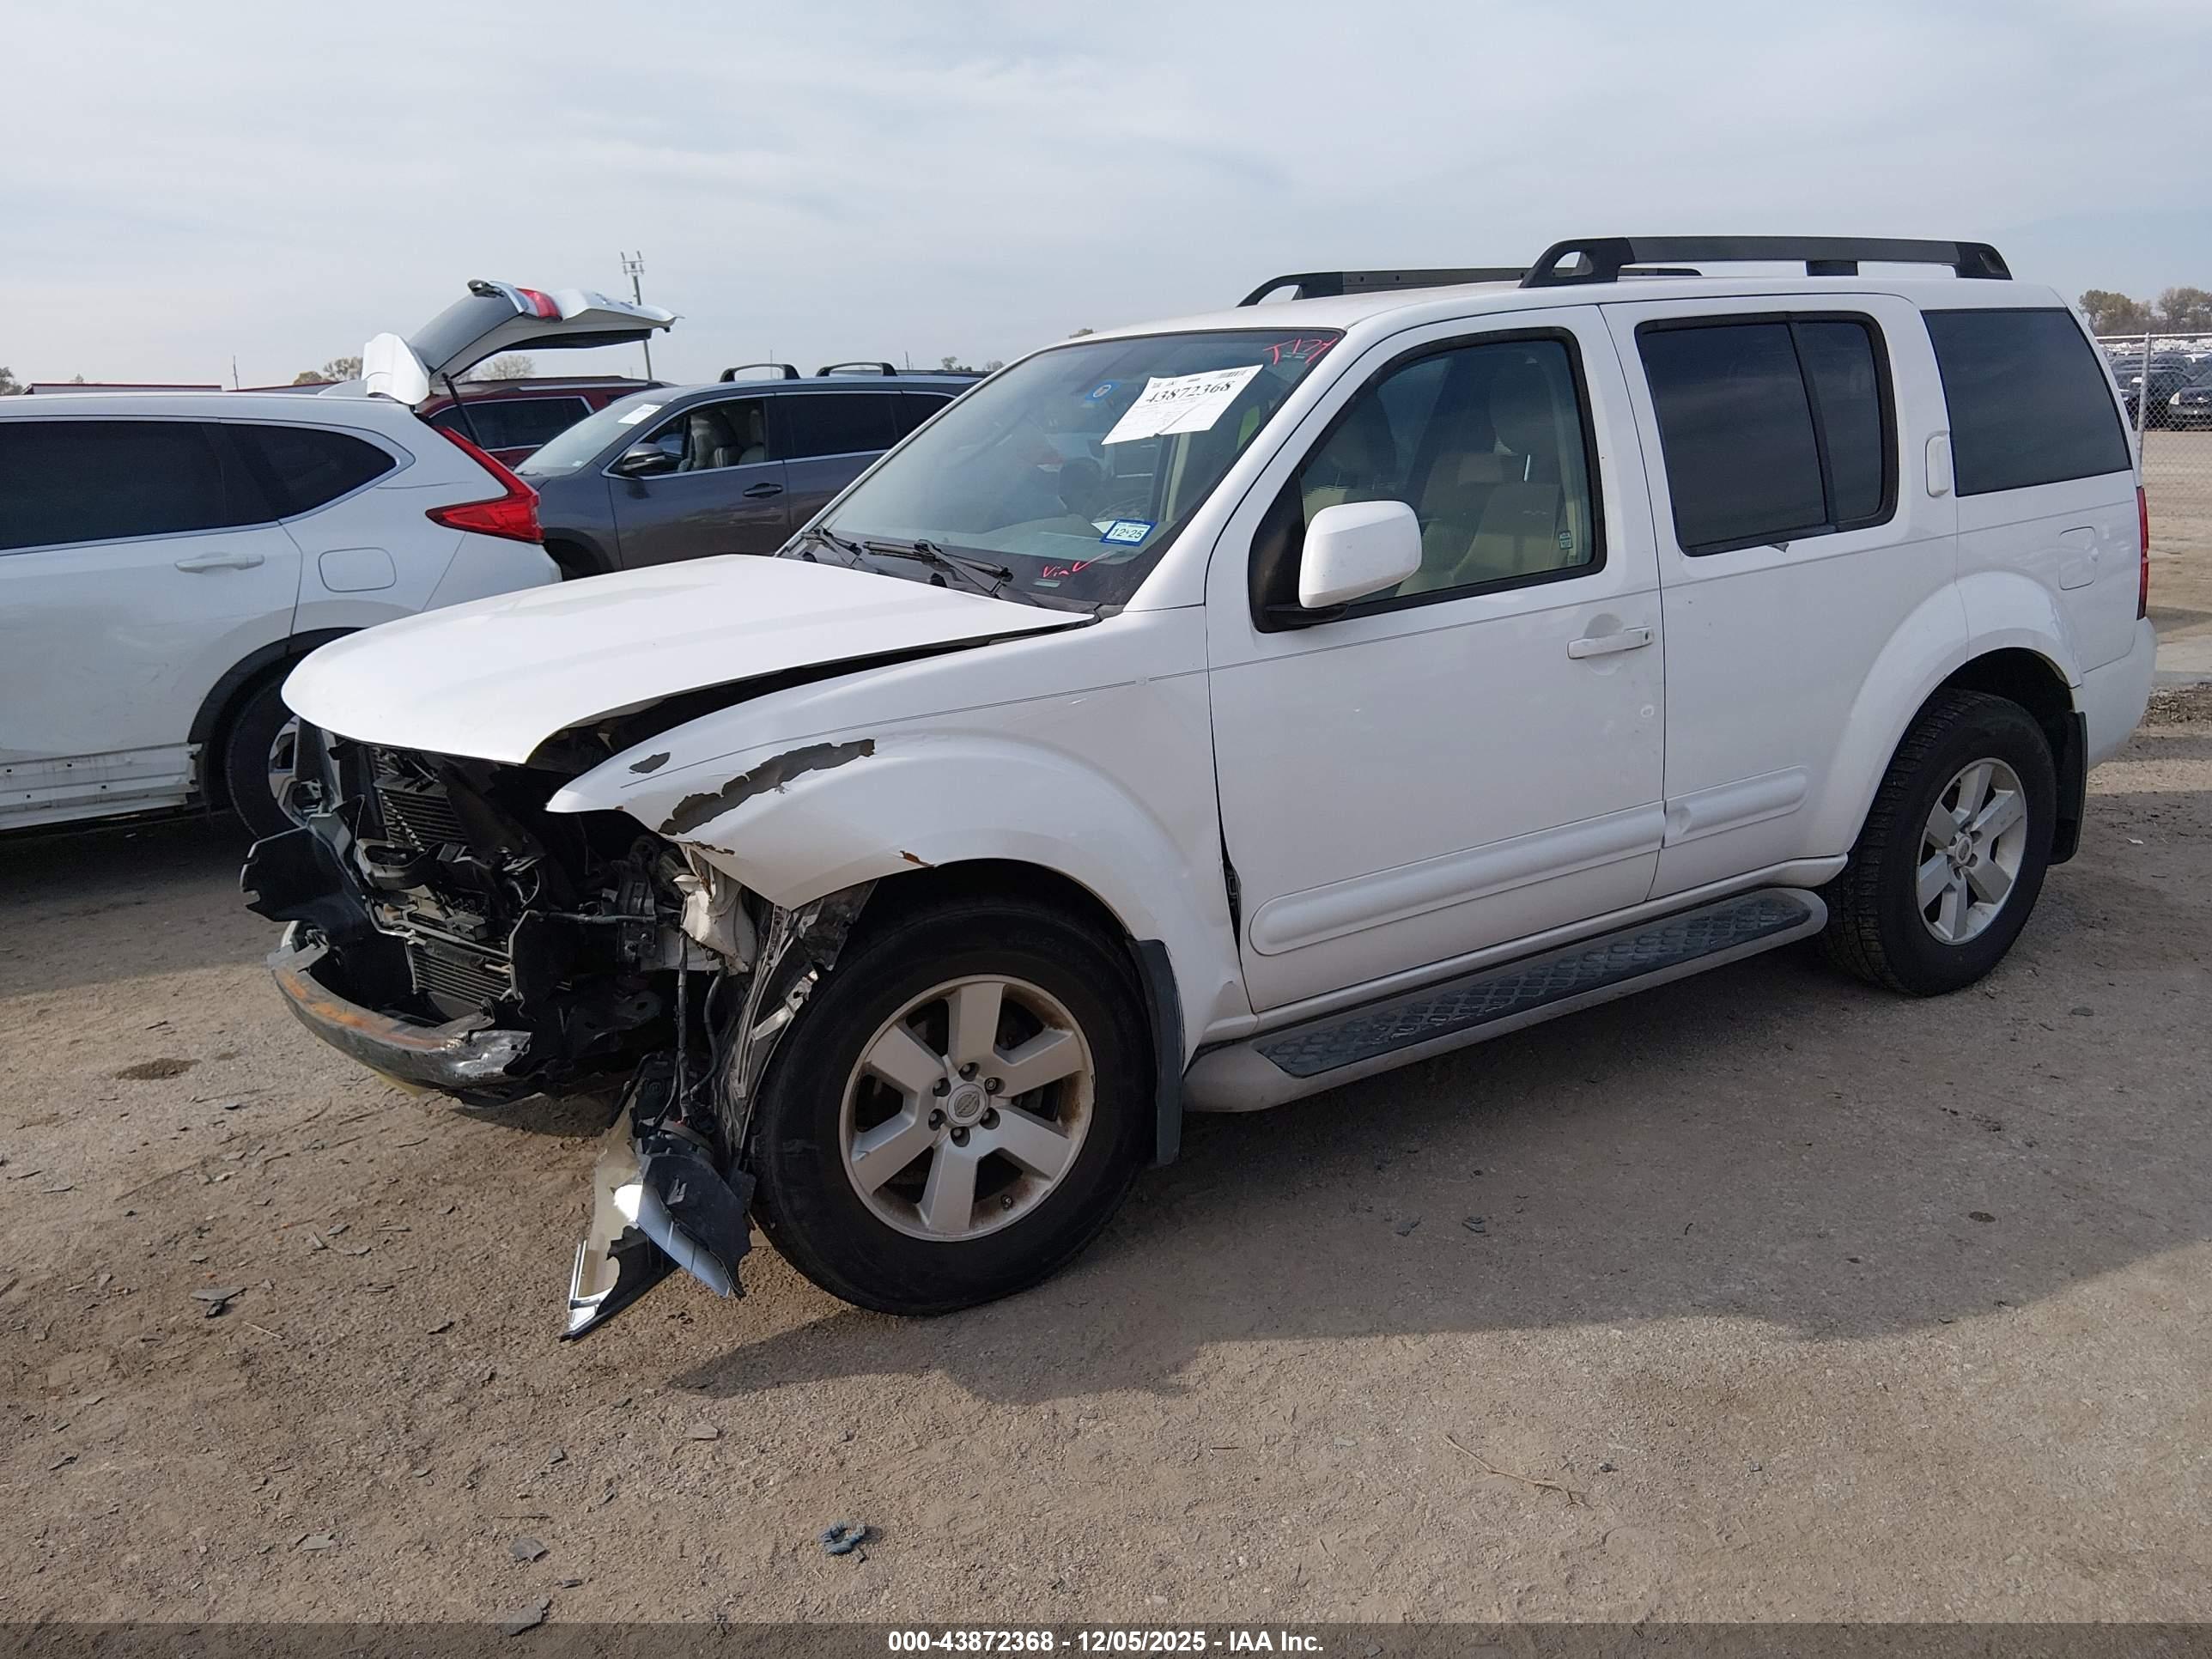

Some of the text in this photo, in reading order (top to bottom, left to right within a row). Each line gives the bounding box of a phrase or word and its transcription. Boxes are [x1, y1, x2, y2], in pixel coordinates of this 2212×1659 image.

[1146, 380, 1236, 402] 43872368
[1112, 528, 1145, 539] 12 25
